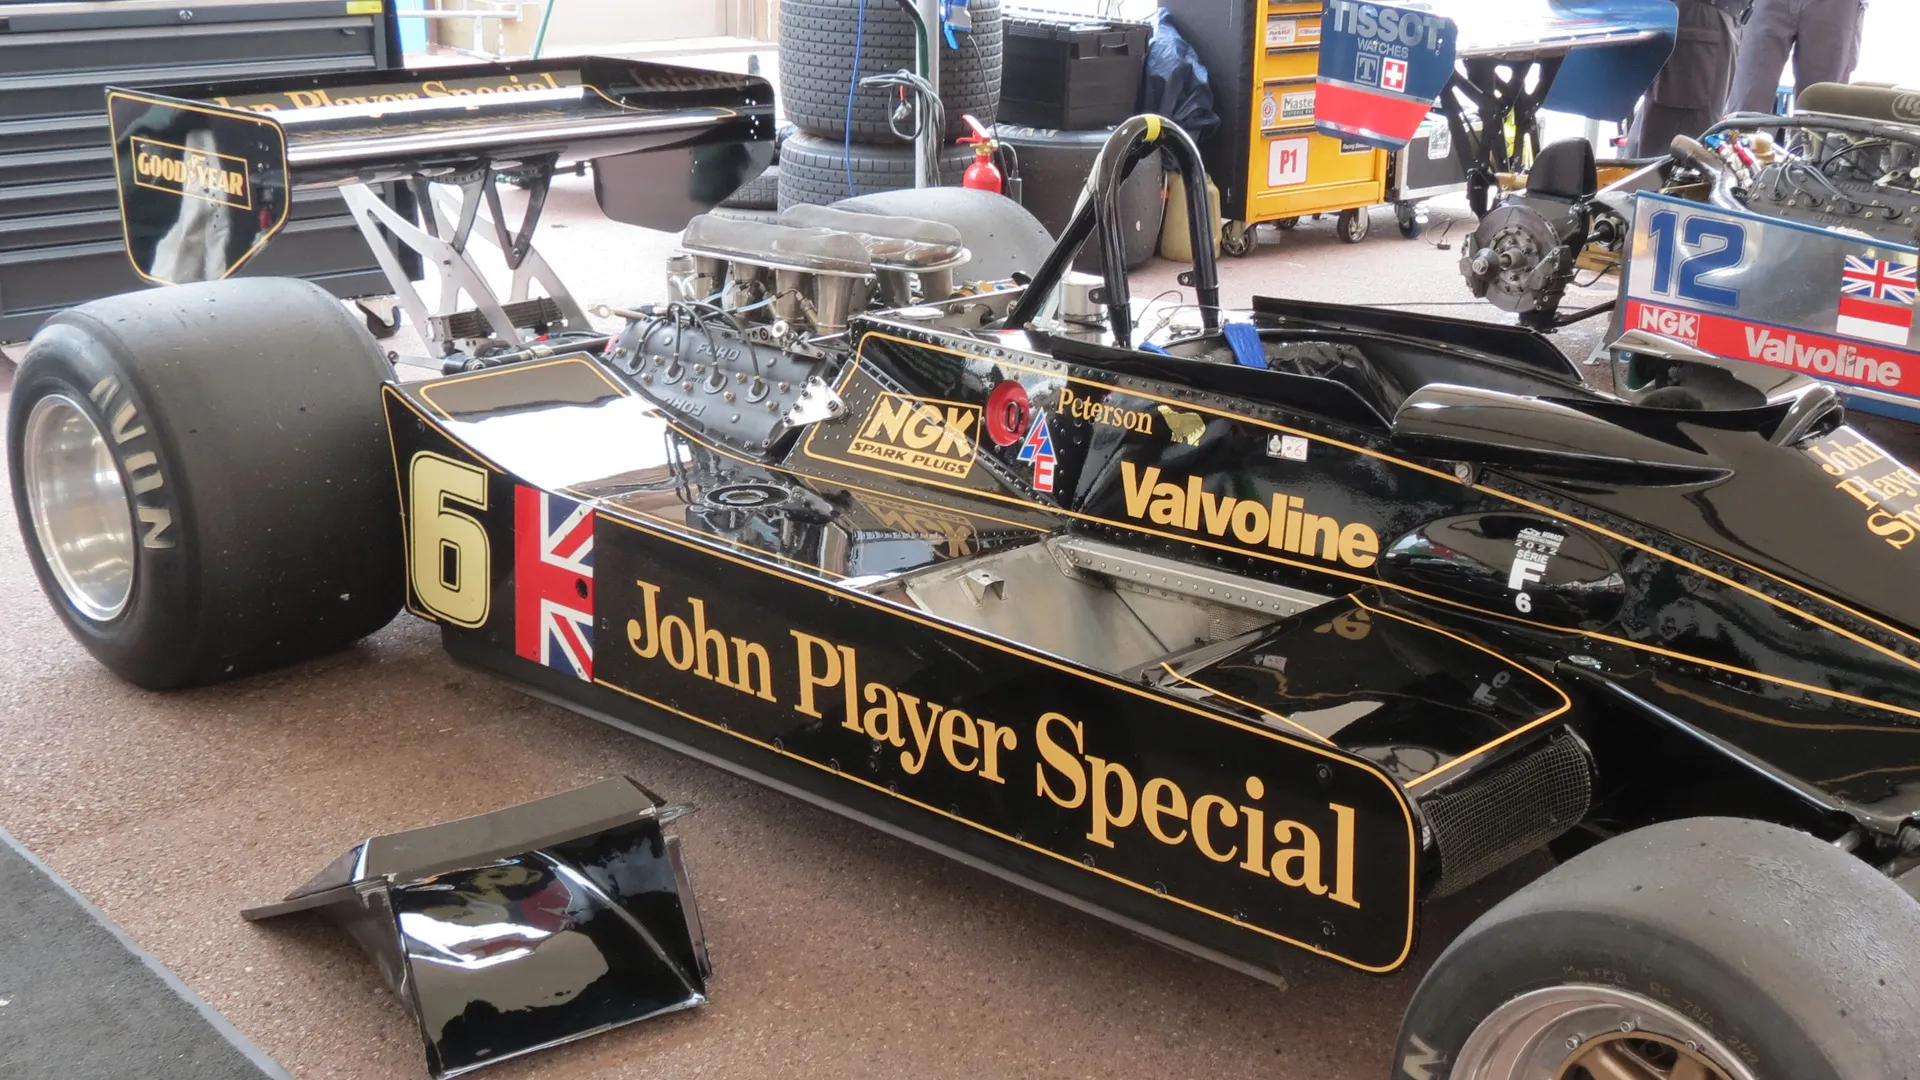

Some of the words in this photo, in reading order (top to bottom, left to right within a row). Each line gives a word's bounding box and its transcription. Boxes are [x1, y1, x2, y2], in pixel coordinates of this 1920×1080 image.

[1329, 0, 1446, 50] TISSOT
[1357, 38, 1409, 59] WATCHES
[1279, 148, 1297, 175] P1
[1648, 209, 1745, 308] 12
[1641, 307, 1697, 338] NGK
[1744, 326, 1902, 387] Valvoline
[861, 397, 976, 457] NGK
[1056, 387, 1154, 435] Peterson
[852, 441, 905, 462] SPARK
[912, 454, 969, 475] PLUGS
[1033, 453, 1055, 491] E
[1808, 439, 1885, 476] John
[1120, 460, 1380, 570] Valvoline
[410, 451, 492, 629] 6
[1515, 549, 1550, 565] SÉRIE
[1508, 558, 1547, 591] F
[1515, 592, 1533, 613] 6
[627, 580, 777, 702] John
[790, 629, 1018, 785] Player
[1035, 711, 1361, 909] Special
